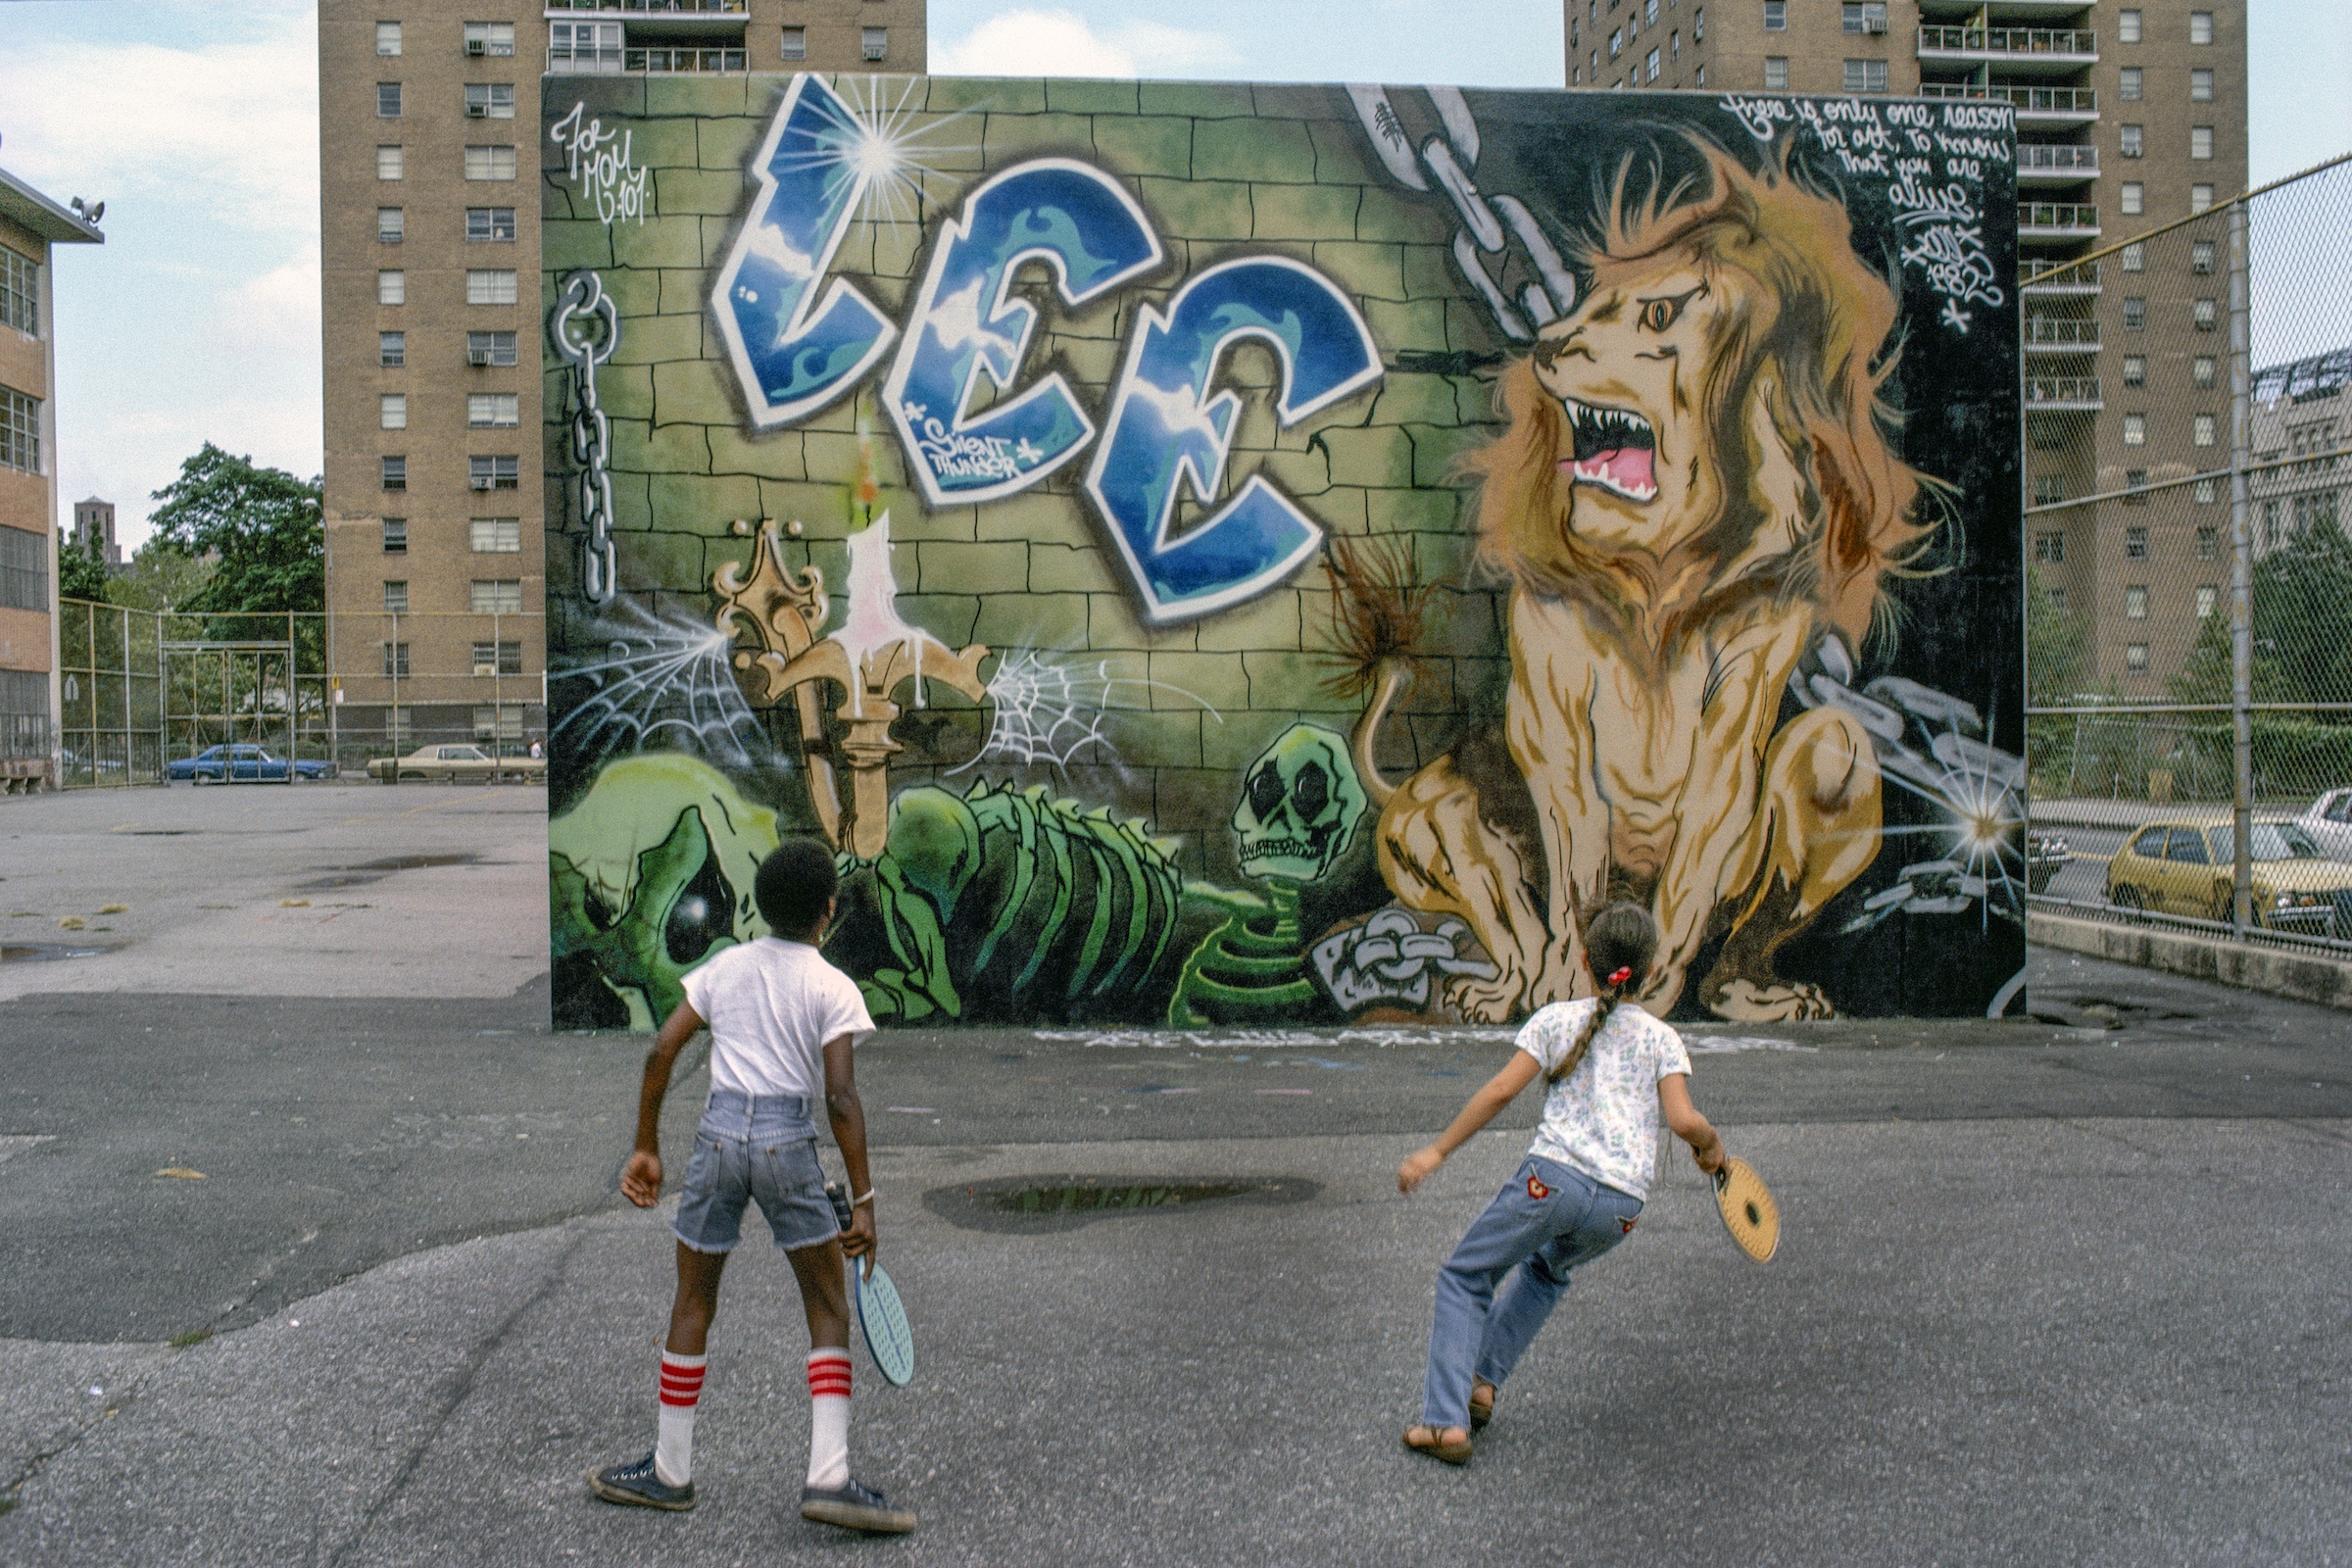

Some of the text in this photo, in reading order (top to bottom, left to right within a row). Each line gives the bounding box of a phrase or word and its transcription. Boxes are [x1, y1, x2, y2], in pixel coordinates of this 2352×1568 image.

[1791, 98, 1817, 124] is
[1824, 98, 1881, 131] only
[1886, 104, 1935, 129] one
[1943, 105, 2017, 133] reason
[1813, 118, 1848, 151] for
[1934, 130, 2011, 164] know
[1836, 148, 1984, 182] That you are
